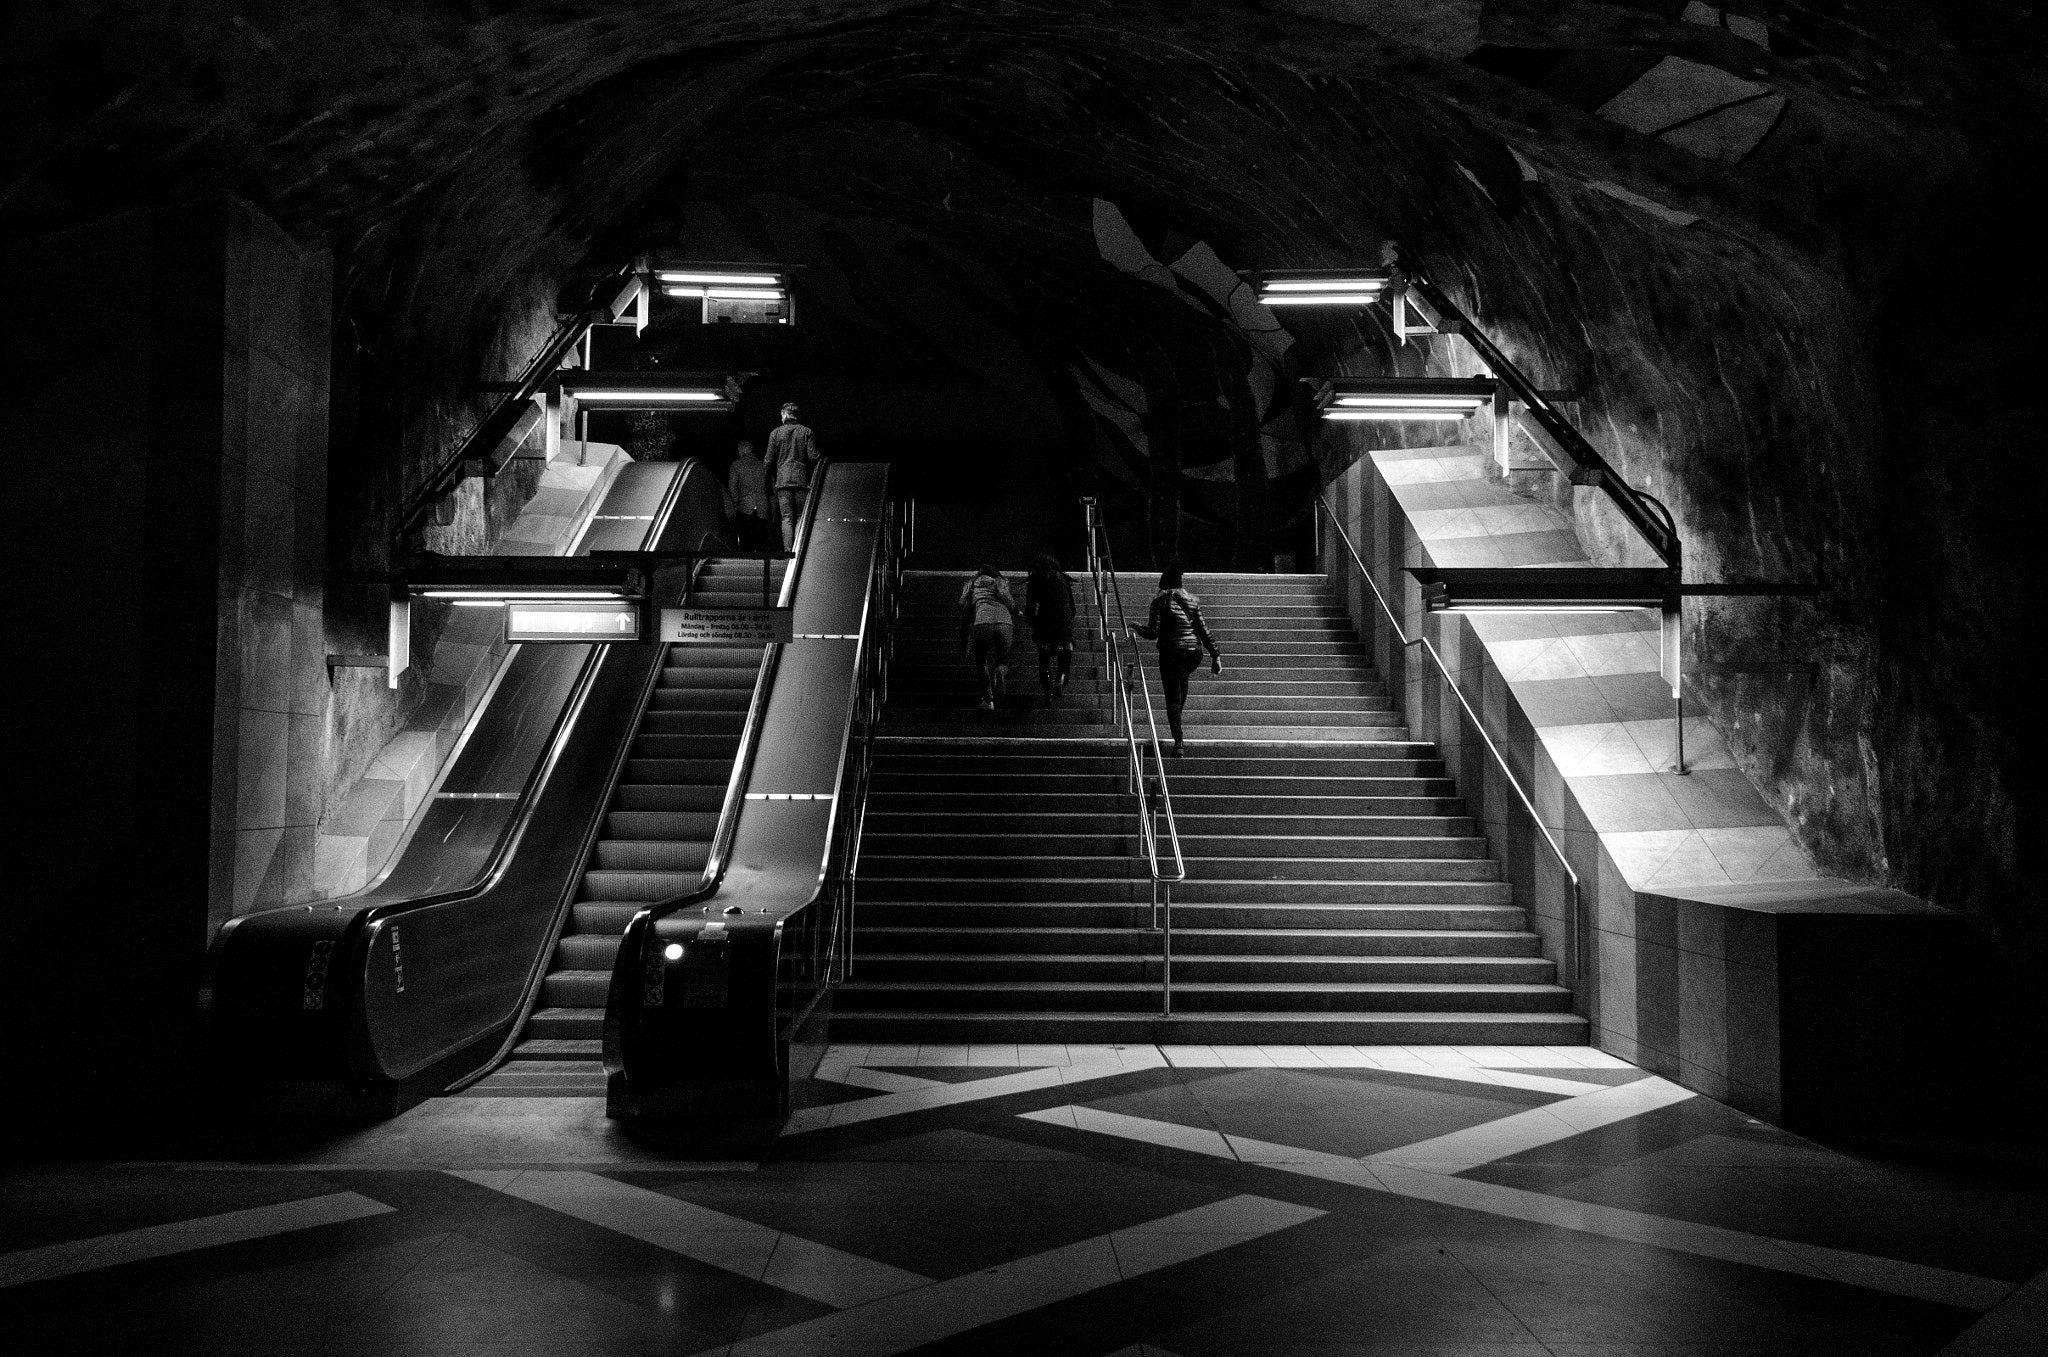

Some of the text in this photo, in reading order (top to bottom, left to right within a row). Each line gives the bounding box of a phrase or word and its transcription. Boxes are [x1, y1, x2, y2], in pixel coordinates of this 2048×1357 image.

[684, 613, 736, 622] Rulltrapporna
[737, 613, 747, 621] är
[752, 613, 770, 622] drift
[710, 623, 730, 631] fredag
